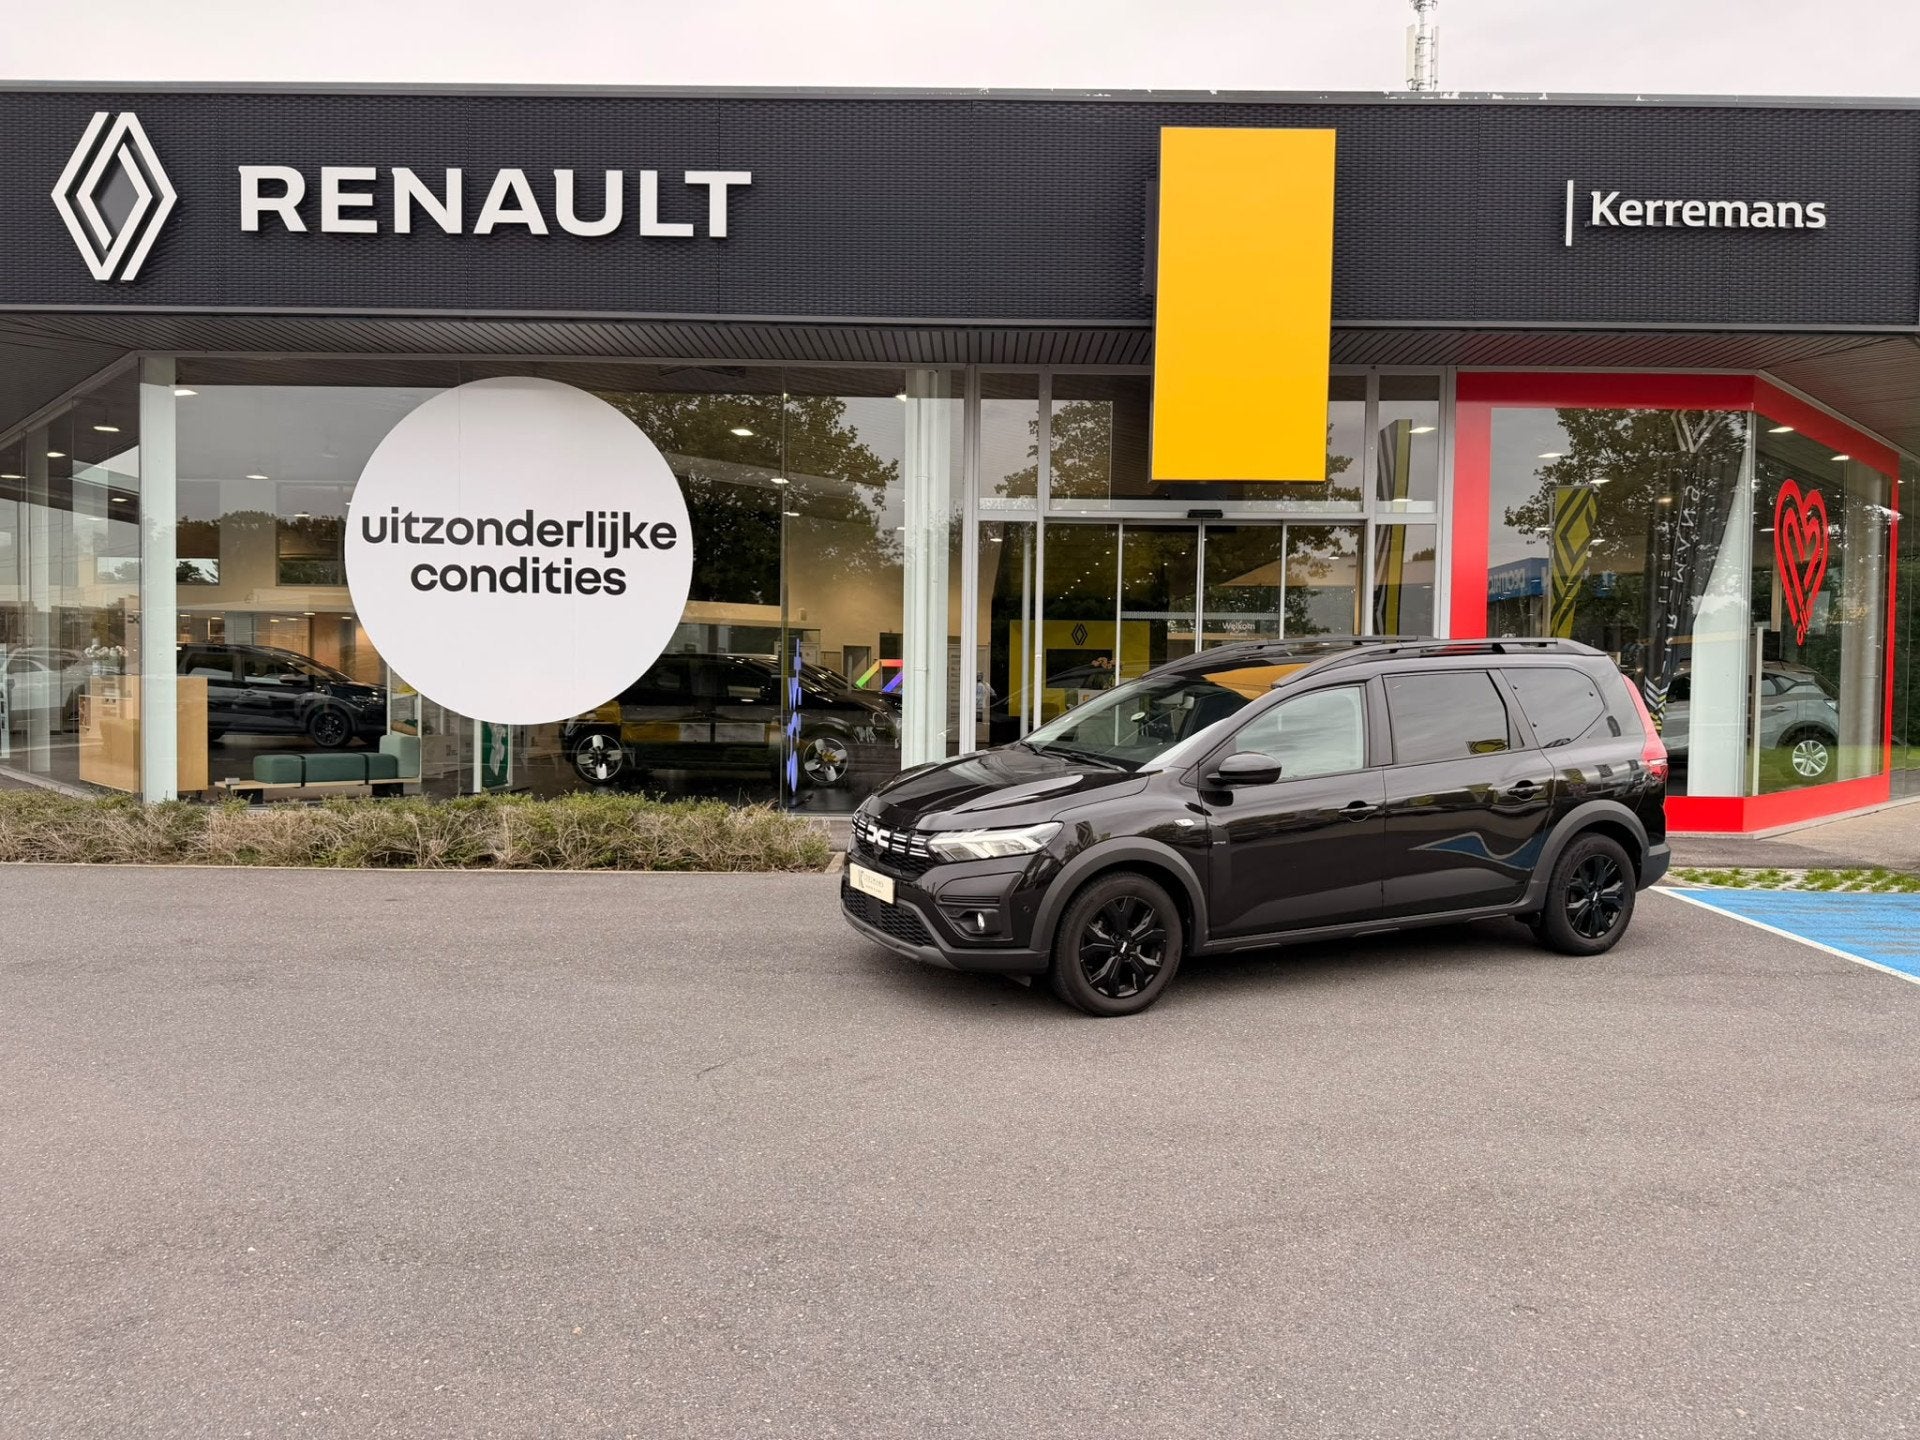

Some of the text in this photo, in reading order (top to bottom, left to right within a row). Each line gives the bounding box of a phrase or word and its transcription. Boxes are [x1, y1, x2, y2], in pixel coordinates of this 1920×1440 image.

[239, 166, 751, 238] RENAULT
[1590, 190, 1827, 230] Kerremans
[362, 507, 677, 558] uitzonderlijke
[411, 558, 627, 596] condities
